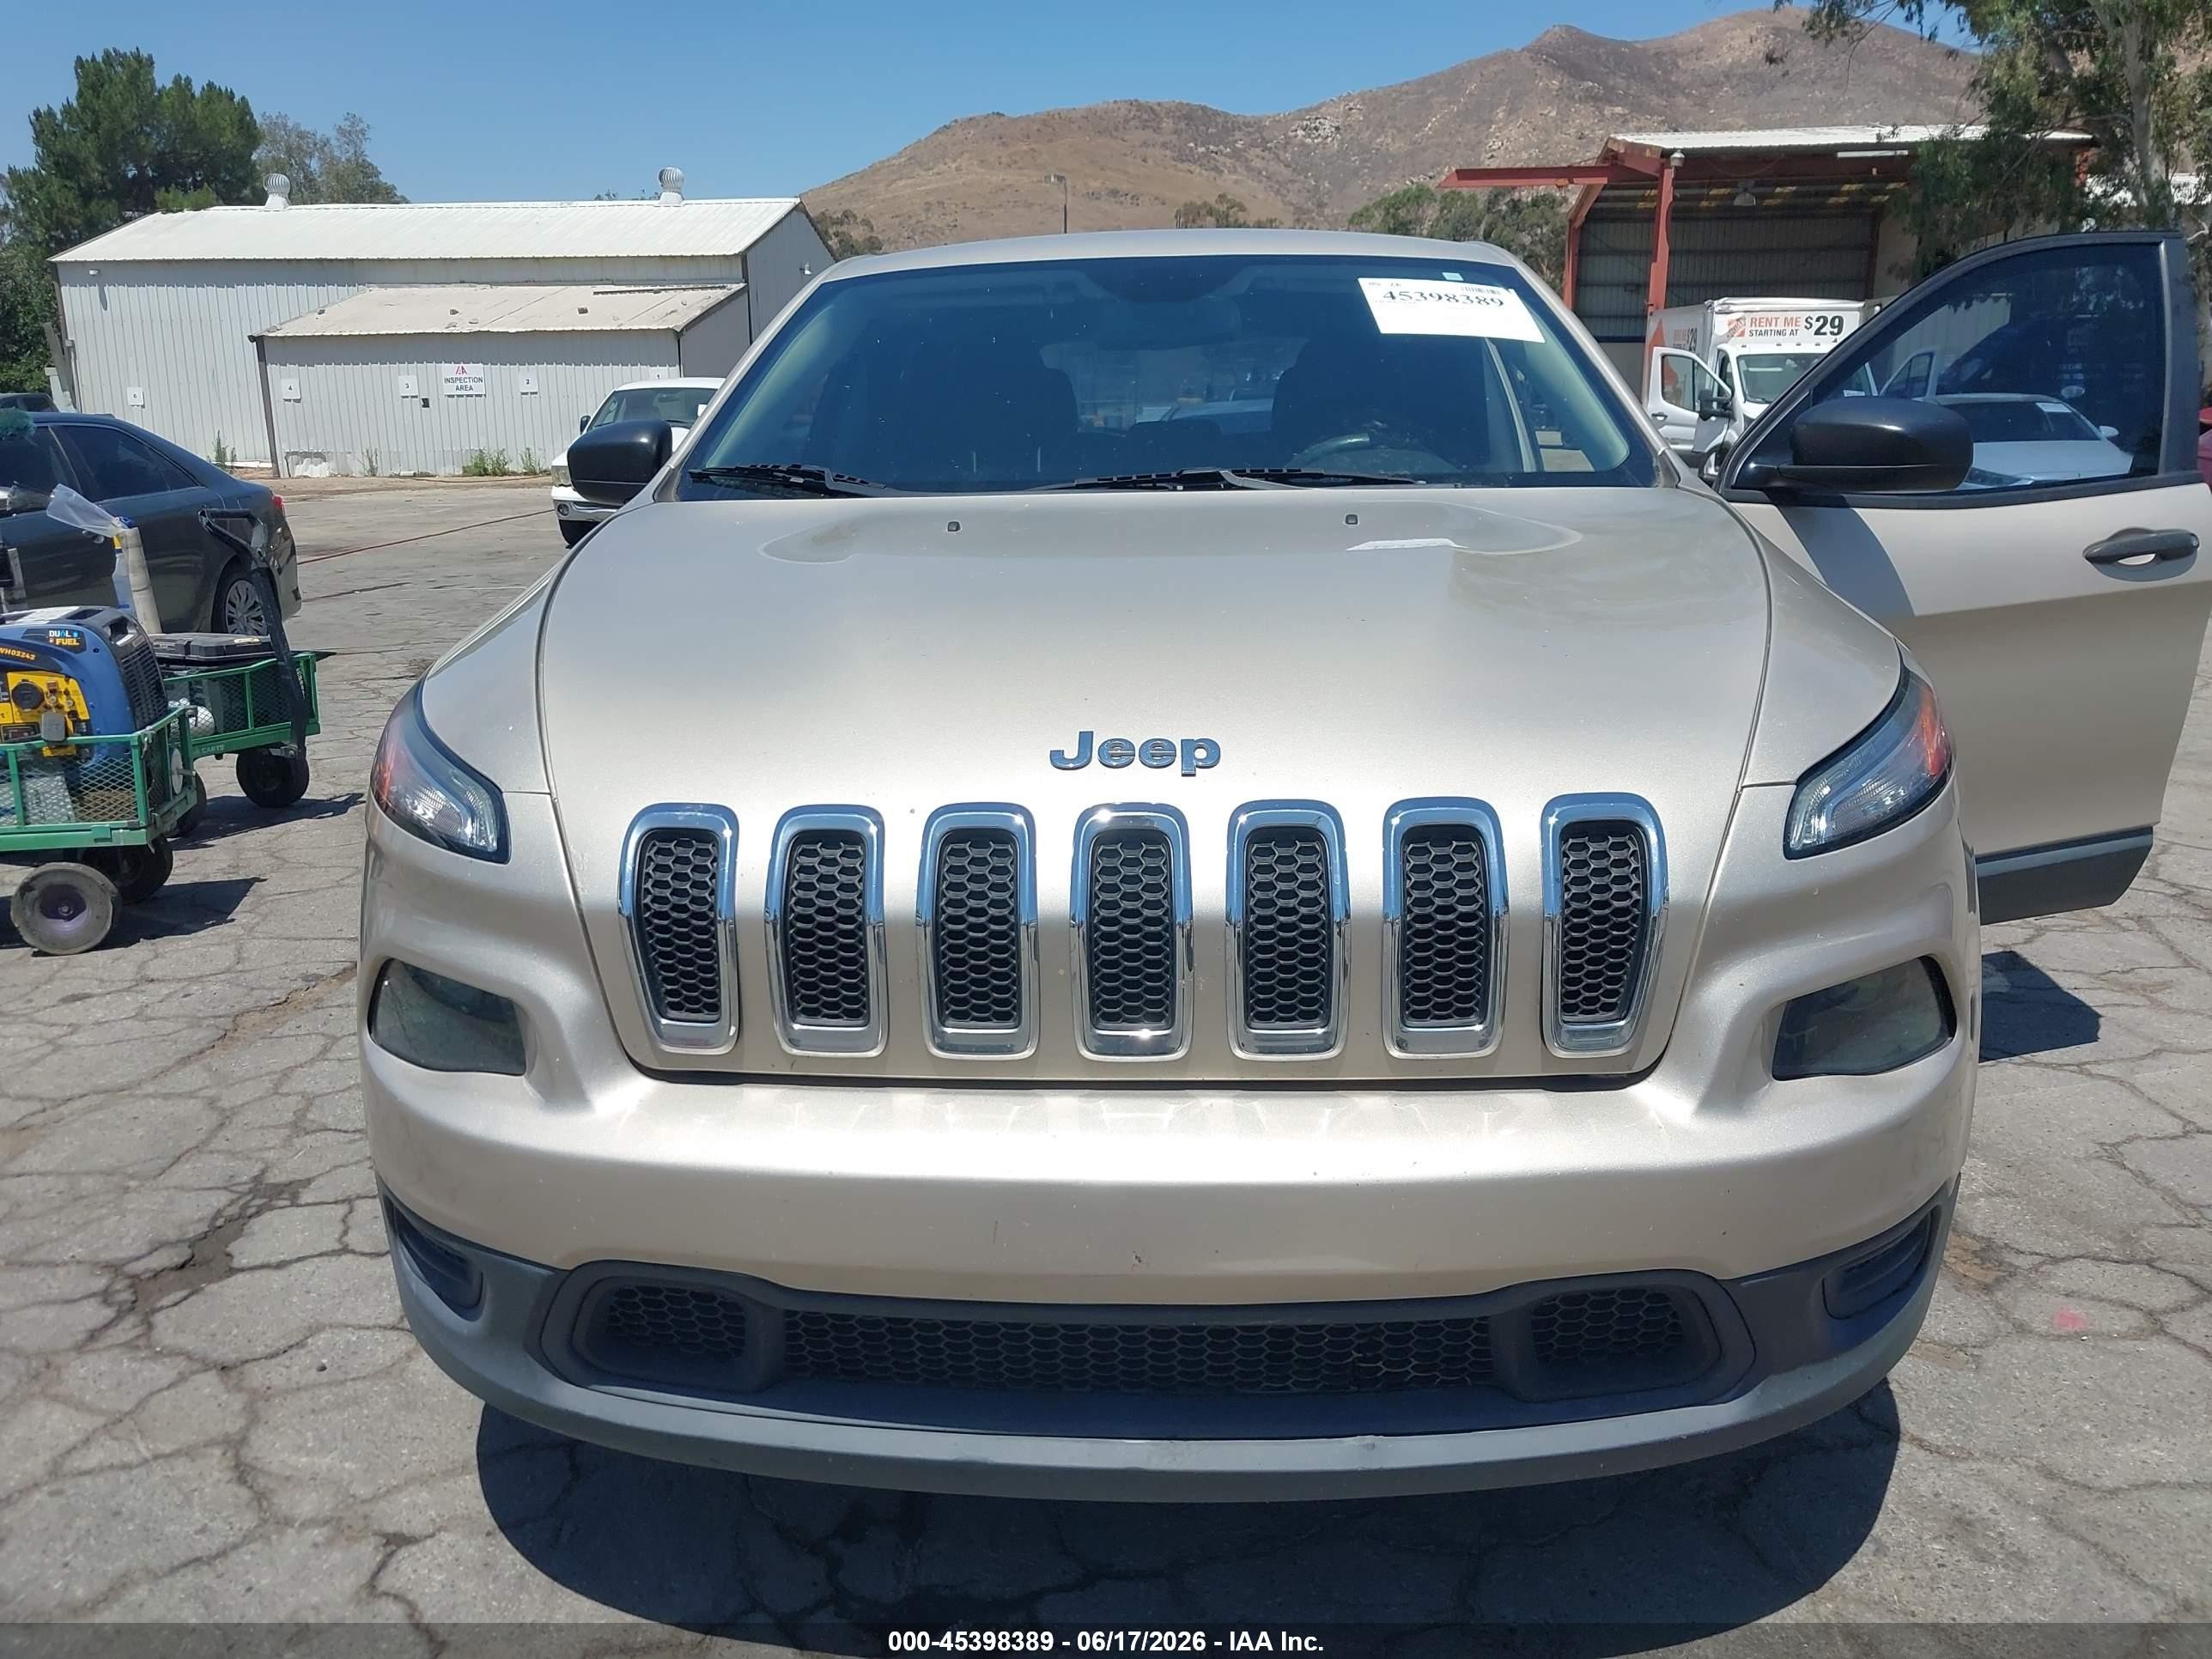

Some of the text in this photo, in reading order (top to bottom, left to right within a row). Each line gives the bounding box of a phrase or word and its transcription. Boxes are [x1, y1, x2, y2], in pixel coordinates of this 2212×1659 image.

[1382, 290, 1504, 307] 45398389
[1748, 329, 1789, 337] STARTING
[1749, 316, 1781, 328] RENT
[1783, 316, 1801, 327] ME
[1804, 315, 1844, 336] $29
[1049, 730, 1221, 777] Jeep
